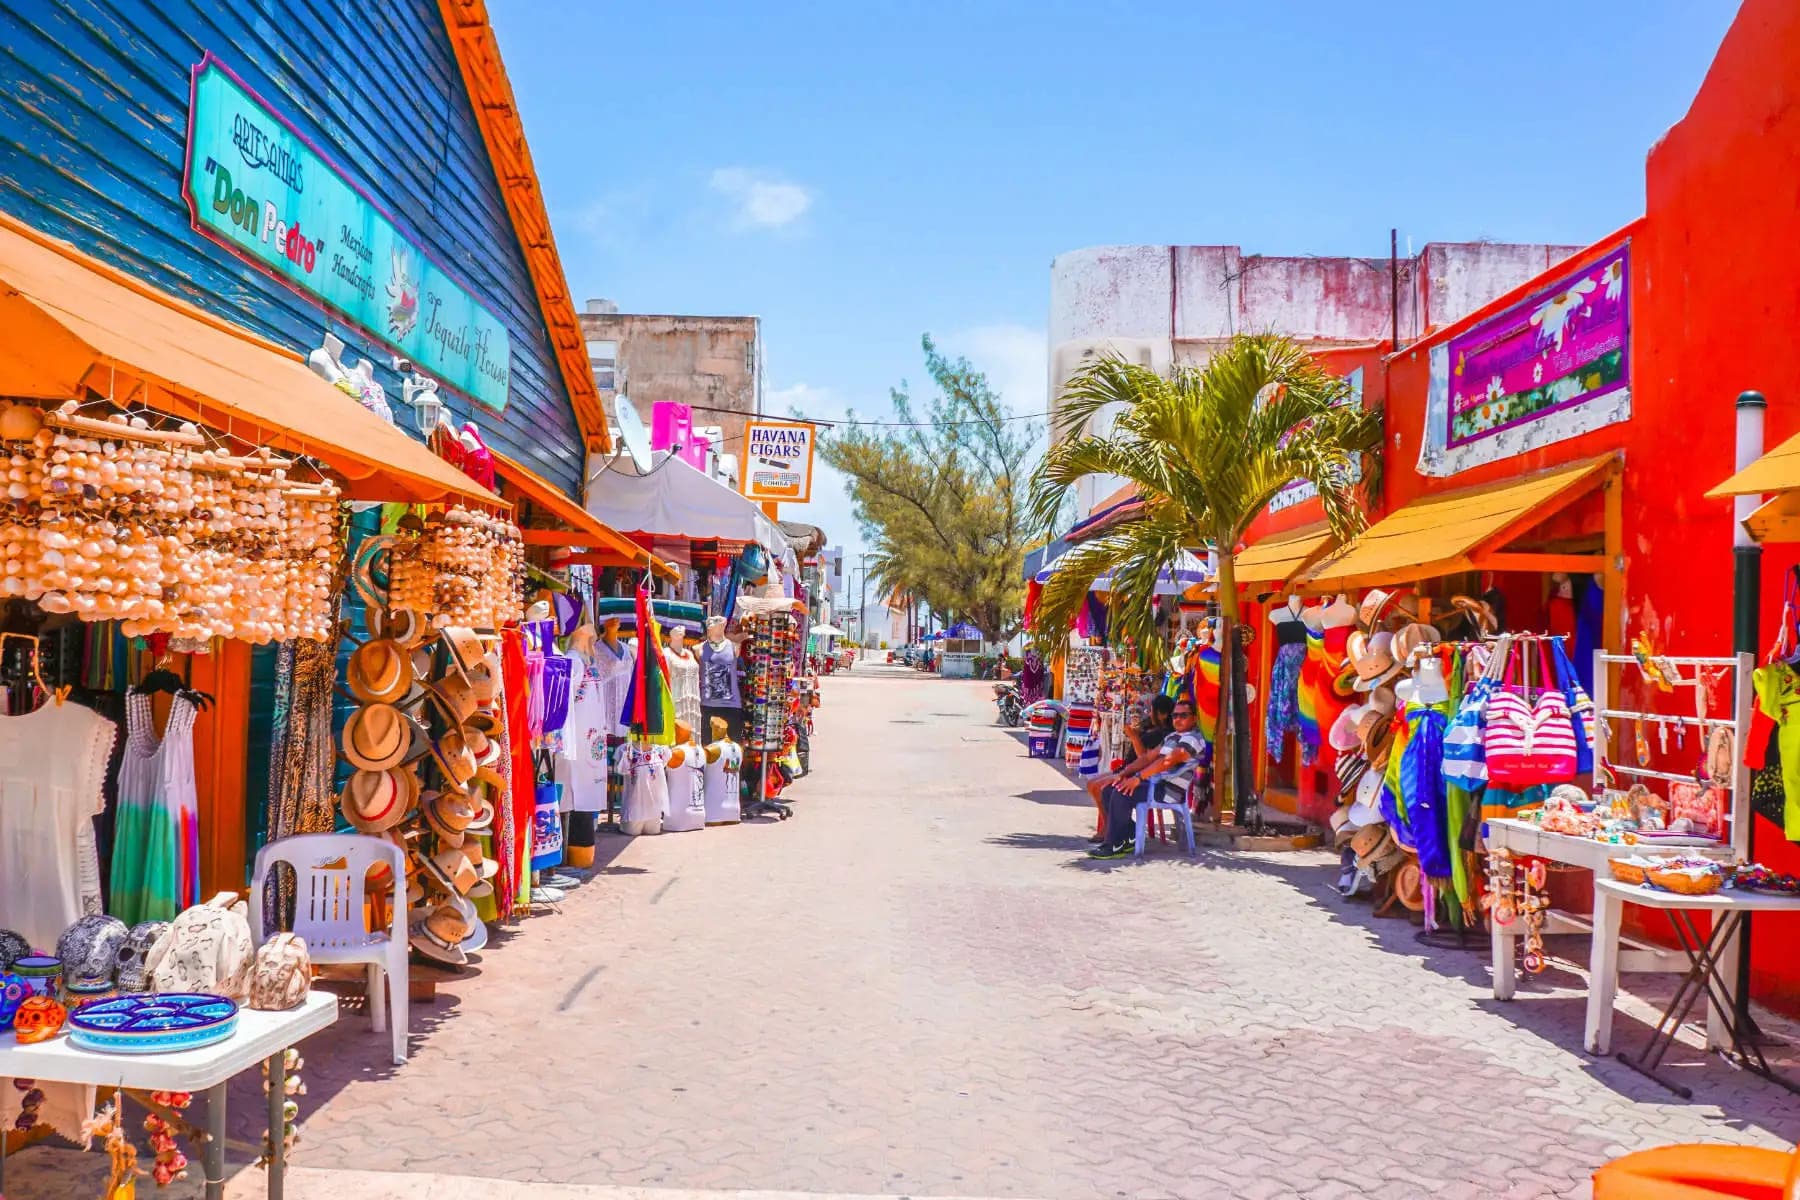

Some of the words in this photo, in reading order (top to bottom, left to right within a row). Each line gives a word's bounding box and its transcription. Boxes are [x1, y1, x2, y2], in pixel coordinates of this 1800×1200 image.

[233, 113, 303, 194] ARTESANIAS
[331, 253, 375, 301] Handcrafts
[425, 291, 471, 361] Tequila
[474, 325, 507, 386] House
[750, 443, 801, 458] CIGARS
[752, 429, 806, 444] HAVANA
